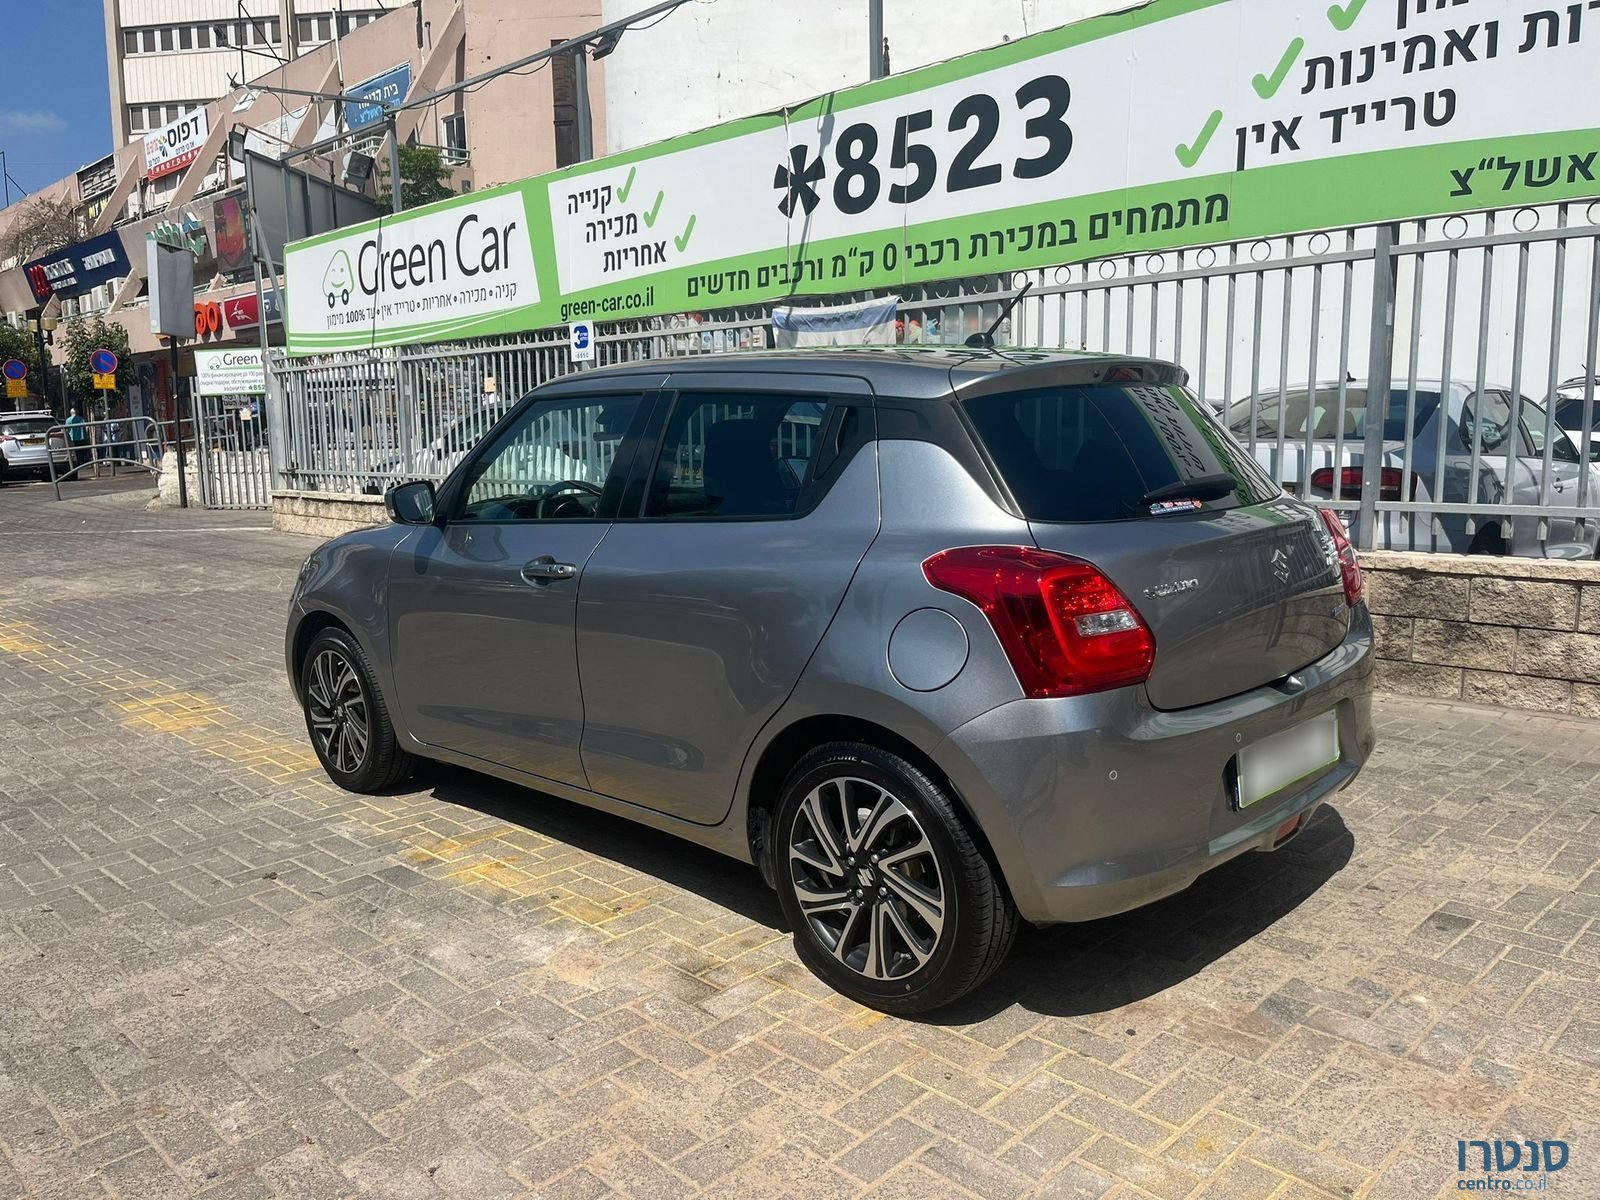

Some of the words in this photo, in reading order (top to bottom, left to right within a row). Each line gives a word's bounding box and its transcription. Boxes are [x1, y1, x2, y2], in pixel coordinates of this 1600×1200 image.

[1517, 0, 1600, 54] ות
[1301, 20, 1499, 95] ואמינות
[383, 83, 399, 99] בית
[167, 115, 199, 148] דפוס
[1319, 88, 1457, 144] טרייד
[1235, 115, 1303, 172] אין
[567, 184, 612, 215] קנייה
[586, 212, 638, 243] מכירה
[1088, 192, 1229, 241] מתמחים
[358, 239, 447, 296] Green
[455, 213, 516, 277] Car
[904, 236, 960, 268] רכבי
[968, 218, 1077, 260] במכירת
[603, 240, 667, 273] אחריות
[882, 242, 897, 272] 0
[687, 269, 750, 298] חדשים
[757, 257, 823, 289] ורכבים
[422, 293, 452, 311] אחריות
[459, 287, 487, 305] מכירה
[495, 282, 517, 301] קניה
[560, 285, 654, 322] green-car.co.il
[326, 313, 344, 330] מימון
[346, 309, 366, 324] 100%
[381, 304, 392, 321] אין
[394, 300, 416, 315] טרייד
[223, 352, 258, 366] Green
